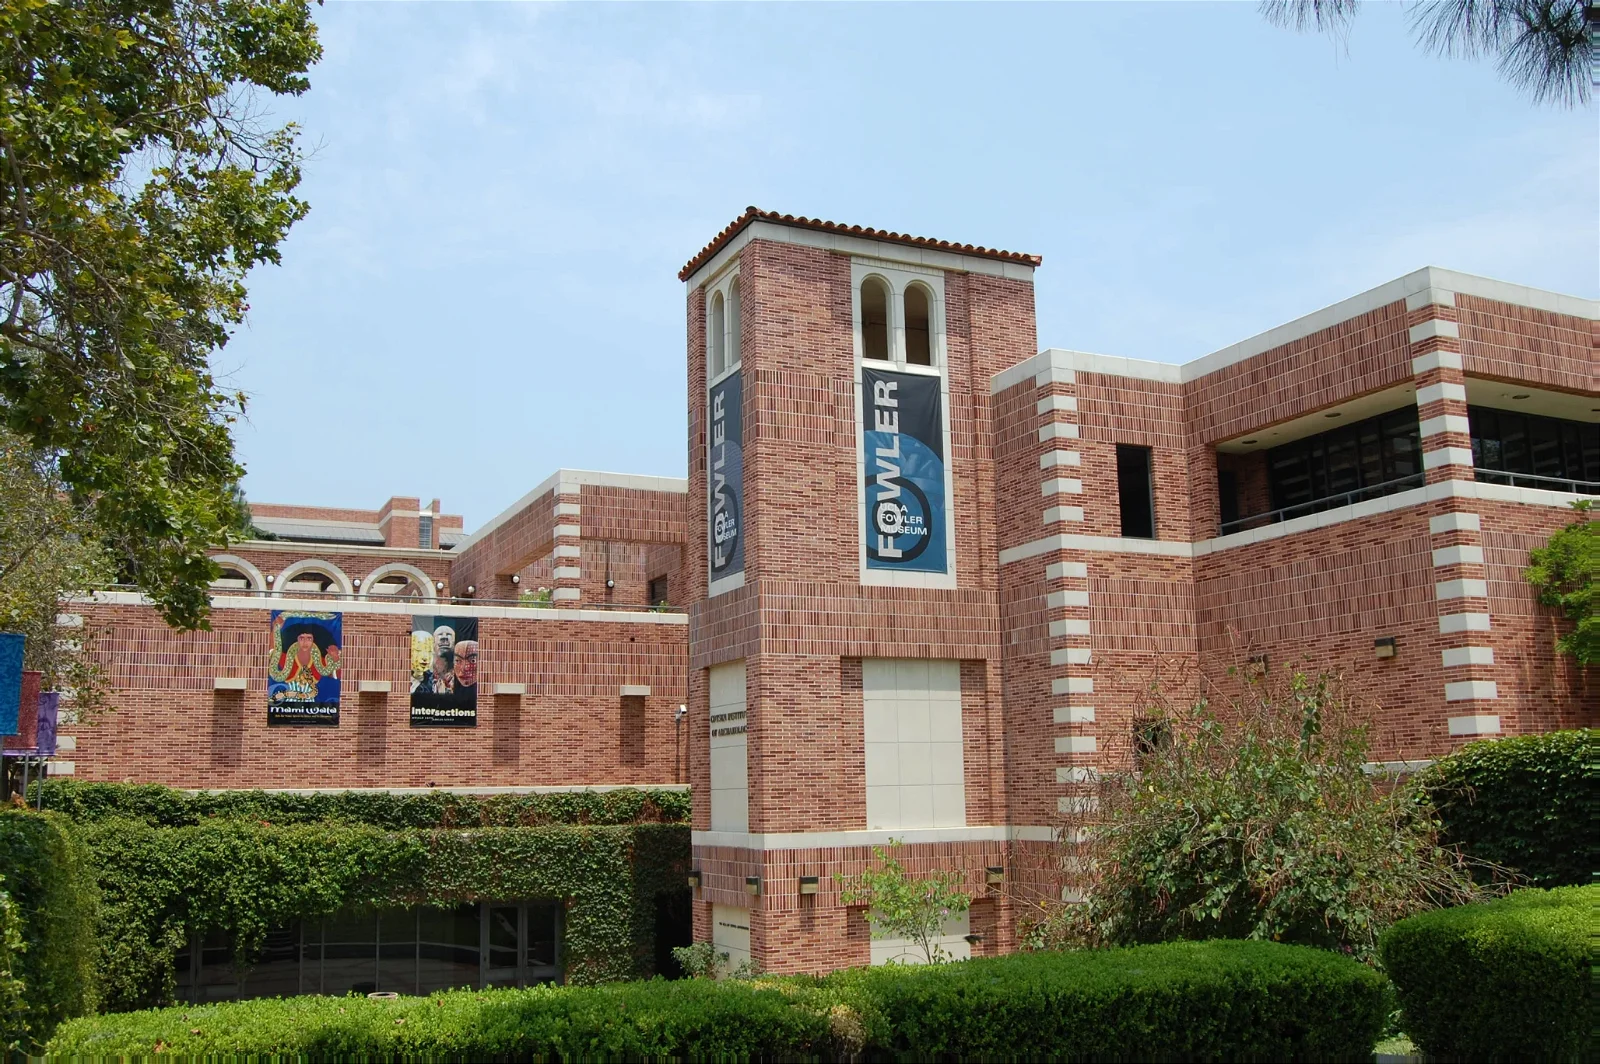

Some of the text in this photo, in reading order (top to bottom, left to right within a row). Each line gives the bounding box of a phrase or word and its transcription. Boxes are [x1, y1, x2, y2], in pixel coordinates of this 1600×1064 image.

[874, 379, 902, 558] FOWLER
[714, 390, 726, 569] FOWLER
[881, 513, 923, 525] FOWLER
[881, 525, 928, 536] MUSEUM
[411, 706, 476, 717] Intersections
